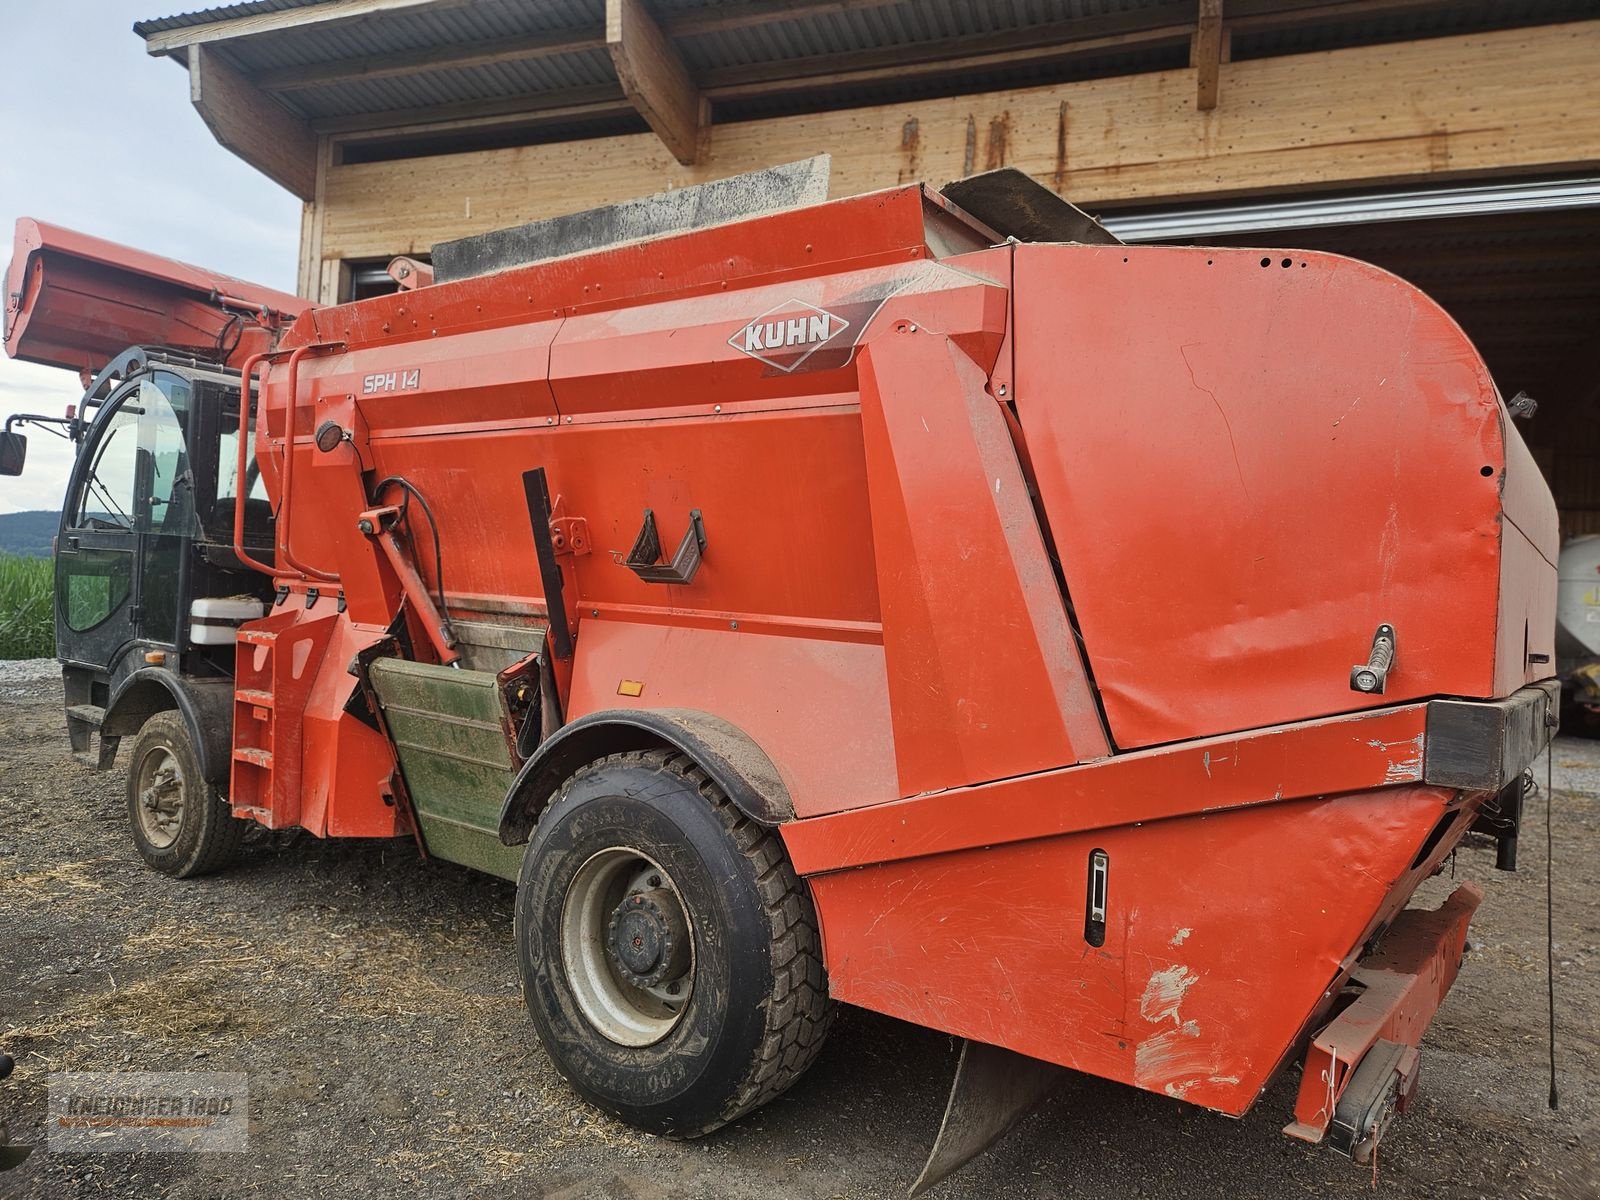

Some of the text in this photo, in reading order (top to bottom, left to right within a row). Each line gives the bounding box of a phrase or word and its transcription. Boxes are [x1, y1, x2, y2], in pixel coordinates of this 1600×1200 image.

[745, 312, 831, 352] KUHN
[363, 368, 421, 394] SPH 14
